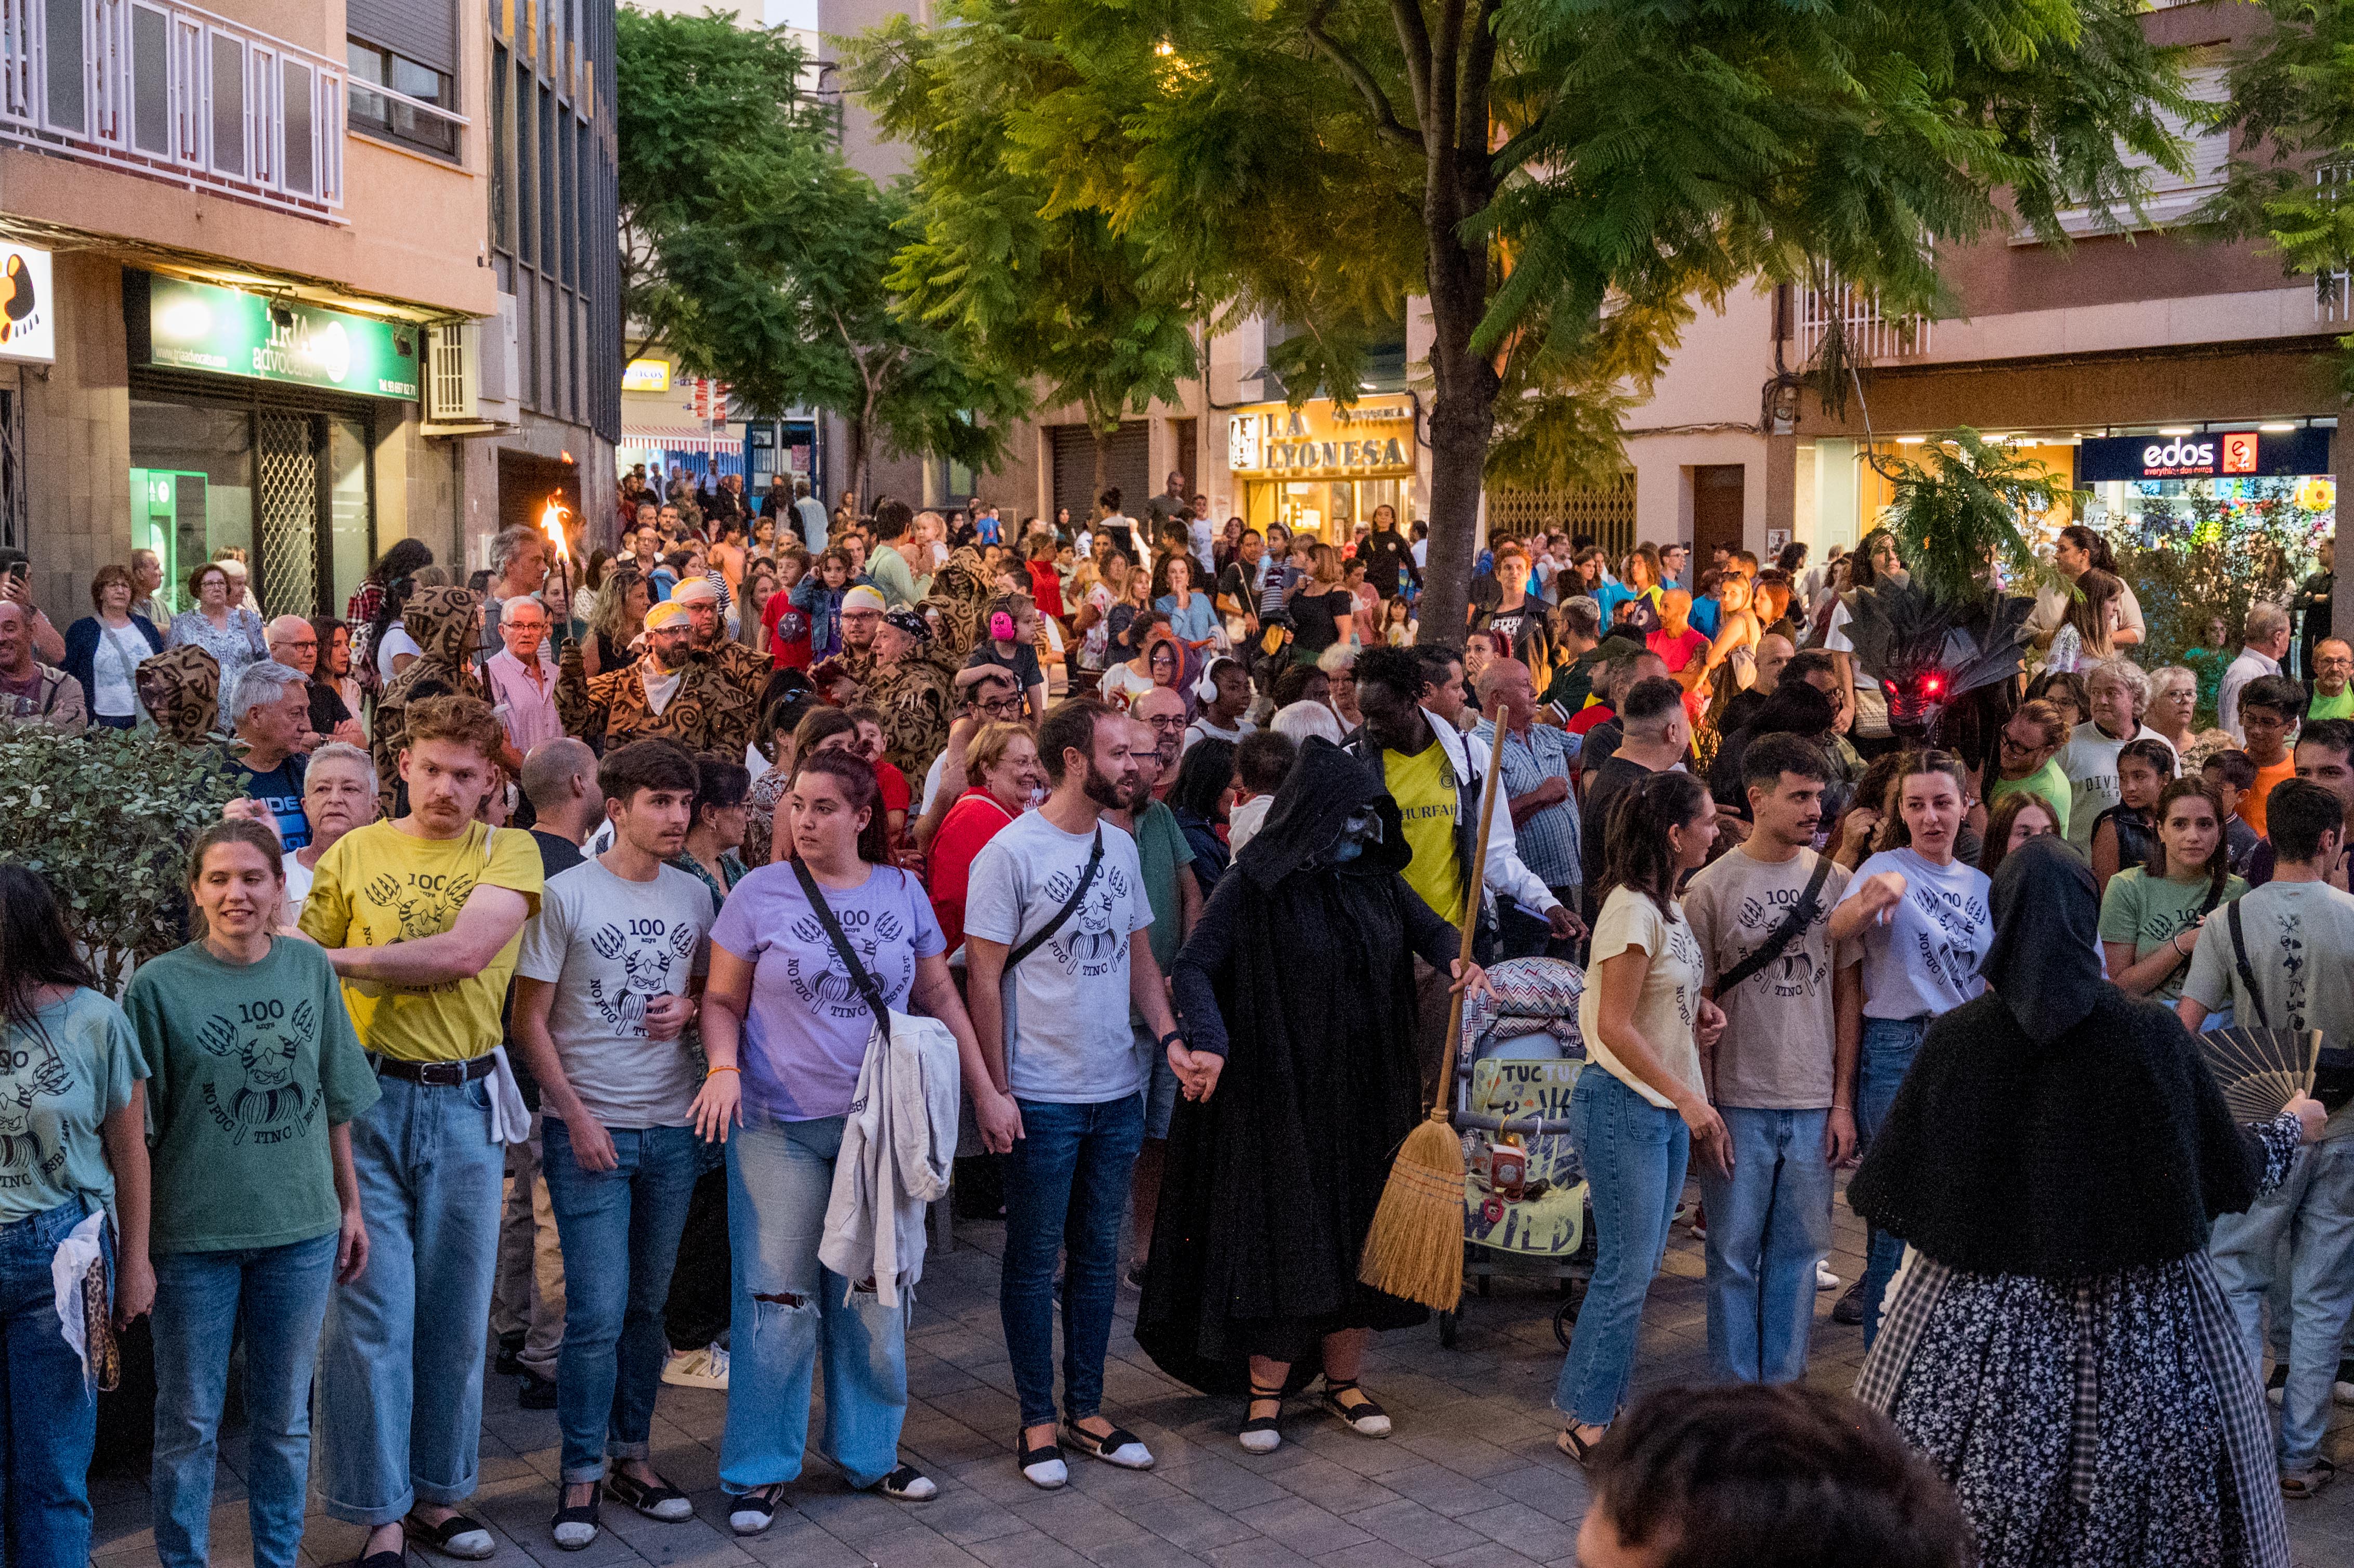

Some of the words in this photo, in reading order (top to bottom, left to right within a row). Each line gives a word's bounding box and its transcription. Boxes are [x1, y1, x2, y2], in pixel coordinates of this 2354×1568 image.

[253, 338, 313, 377] advocats
[1266, 411, 1307, 437] LA
[1266, 437, 1405, 468] LYONESA
[2144, 437, 2214, 467] edos
[2144, 467, 2177, 476] everythin
[1767, 889, 1800, 905] 100
[1942, 893, 1960, 907] 00
[629, 919, 665, 936] 100
[833, 910, 869, 926] 100
[363, 926, 373, 946] NO
[1919, 932, 1929, 949] NO
[788, 958, 800, 976] NO
[1048, 940, 1068, 963] PUC
[1083, 963, 1108, 976] TINC
[1922, 950, 1942, 974] PUC
[591, 979, 602, 998] NO
[790, 977, 814, 1002] PUC
[884, 956, 911, 1006] ESBART
[1676, 985, 1684, 1003] NO
[1775, 985, 1802, 997] TINC
[239, 999, 284, 1024] 100
[595, 999, 618, 1023] PUC
[831, 1005, 867, 1018] TINC
[256, 1022, 275, 1030] anys
[633, 1026, 651, 1037] TI
[0, 1049, 29, 1069] 00
[203, 1081, 217, 1105] NO
[304, 1089, 323, 1126] ESBA
[848, 1095, 868, 1114] ESB
[208, 1103, 235, 1132] PUC
[254, 1126, 292, 1144] TINC
[0, 1173, 32, 1188] INC
